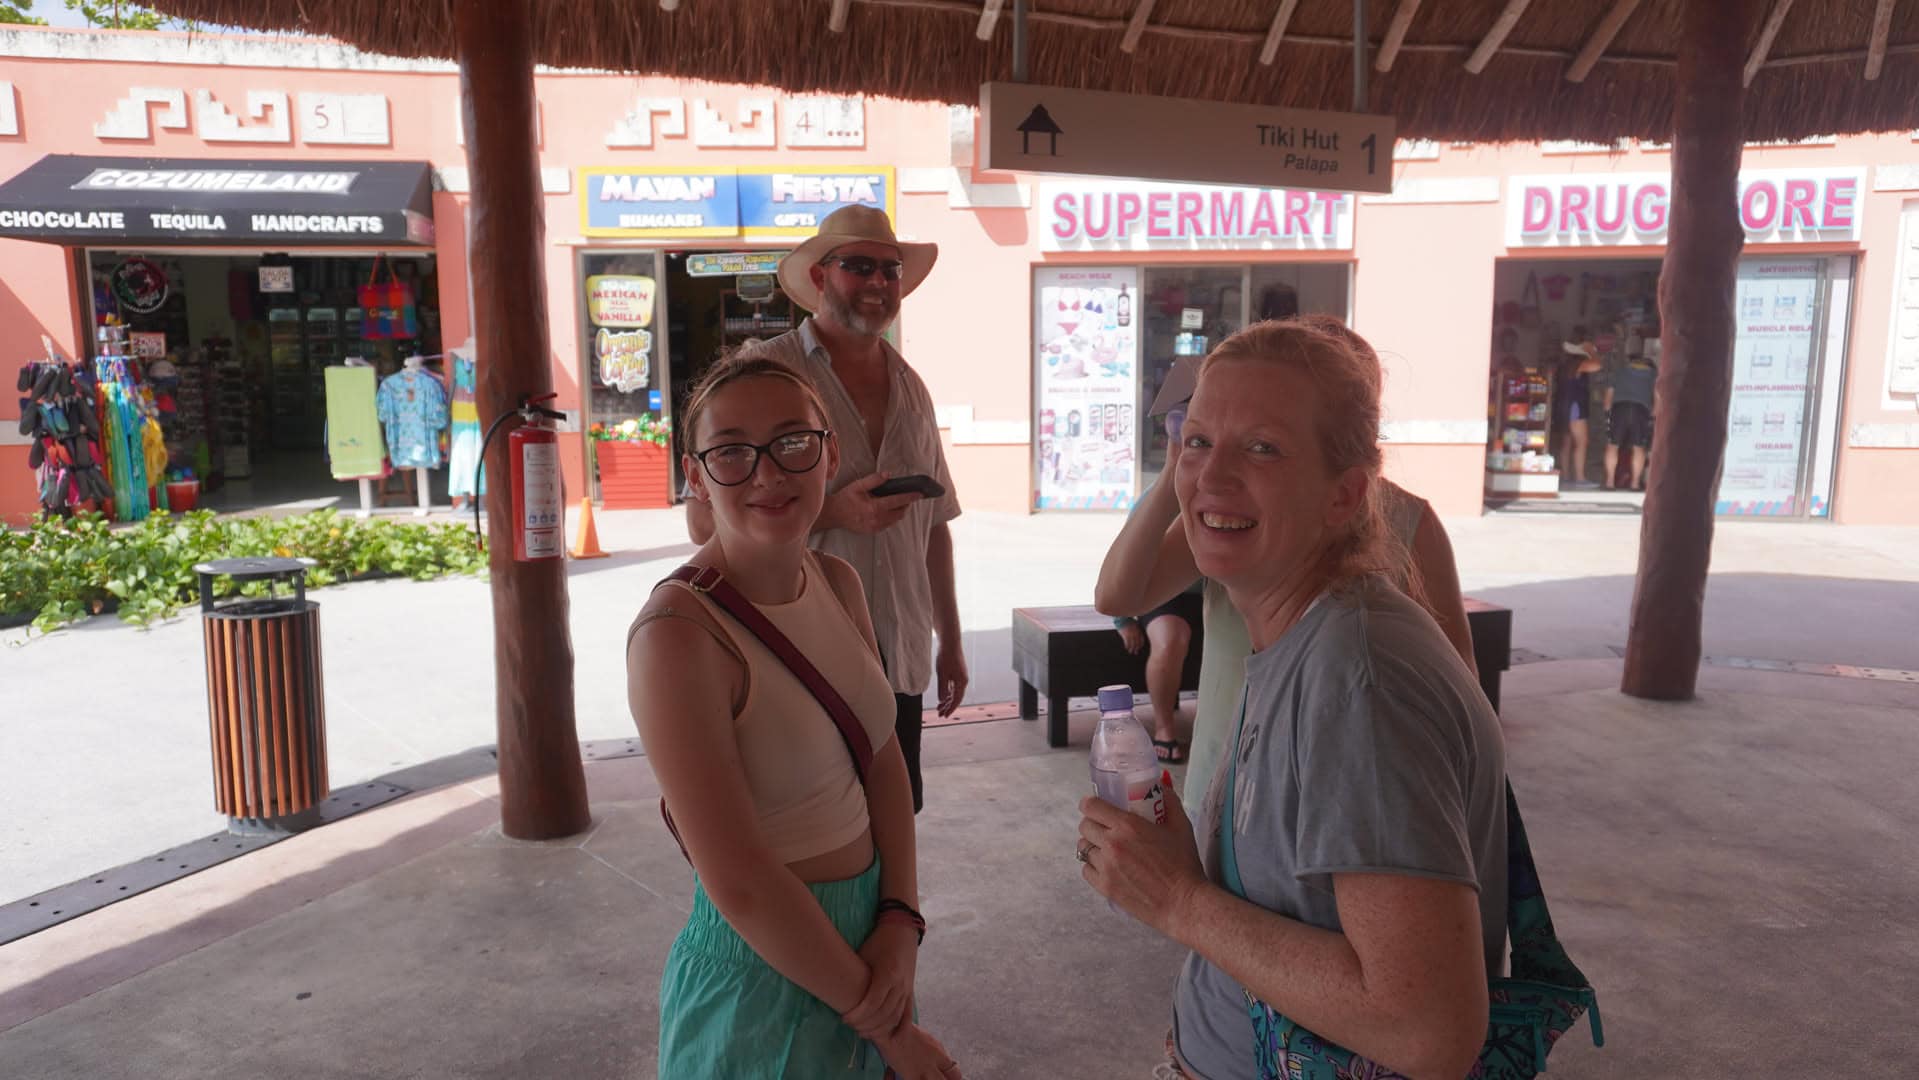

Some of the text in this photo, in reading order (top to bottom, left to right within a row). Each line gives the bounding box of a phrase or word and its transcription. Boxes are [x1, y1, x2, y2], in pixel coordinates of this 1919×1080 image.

[1255, 124, 1377, 175] Tiki Hut 1
[1283, 153, 1339, 174] Palapa
[88, 168, 352, 193] COZUMELAND
[600, 173, 876, 204] MAYAN FIESTA
[1051, 189, 1346, 241] SUPERMART
[1522, 176, 1858, 235] DRUGORE
[0, 210, 385, 234] CHOCOLATE TEQUILA HANDCRAFTS
[773, 212, 817, 228] GIFTS
[591, 289, 648, 301] MEXICAN
[596, 311, 642, 323] VANILLA
